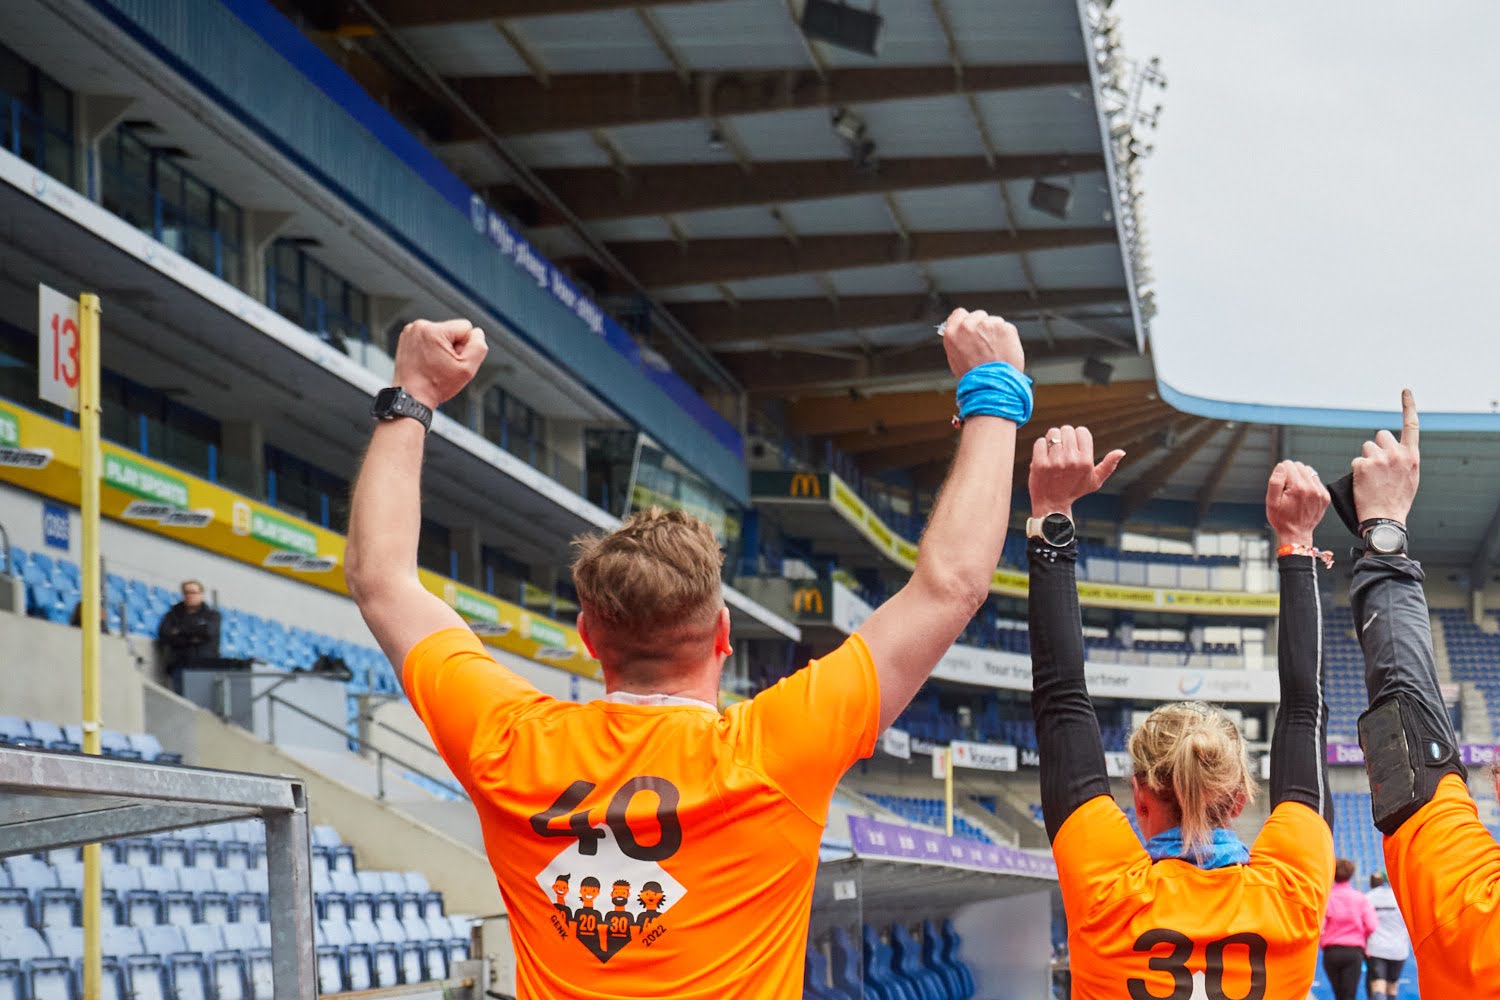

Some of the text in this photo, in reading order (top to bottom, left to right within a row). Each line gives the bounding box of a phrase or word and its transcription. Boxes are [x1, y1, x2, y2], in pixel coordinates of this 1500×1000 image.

[51, 311, 80, 388] 13
[1086, 672, 1129, 688] artner
[529, 776, 682, 861] 40
[550, 914, 570, 941] GENK
[579, 915, 596, 931] 20
[611, 916, 628, 933] 30
[642, 924, 668, 947] 2022
